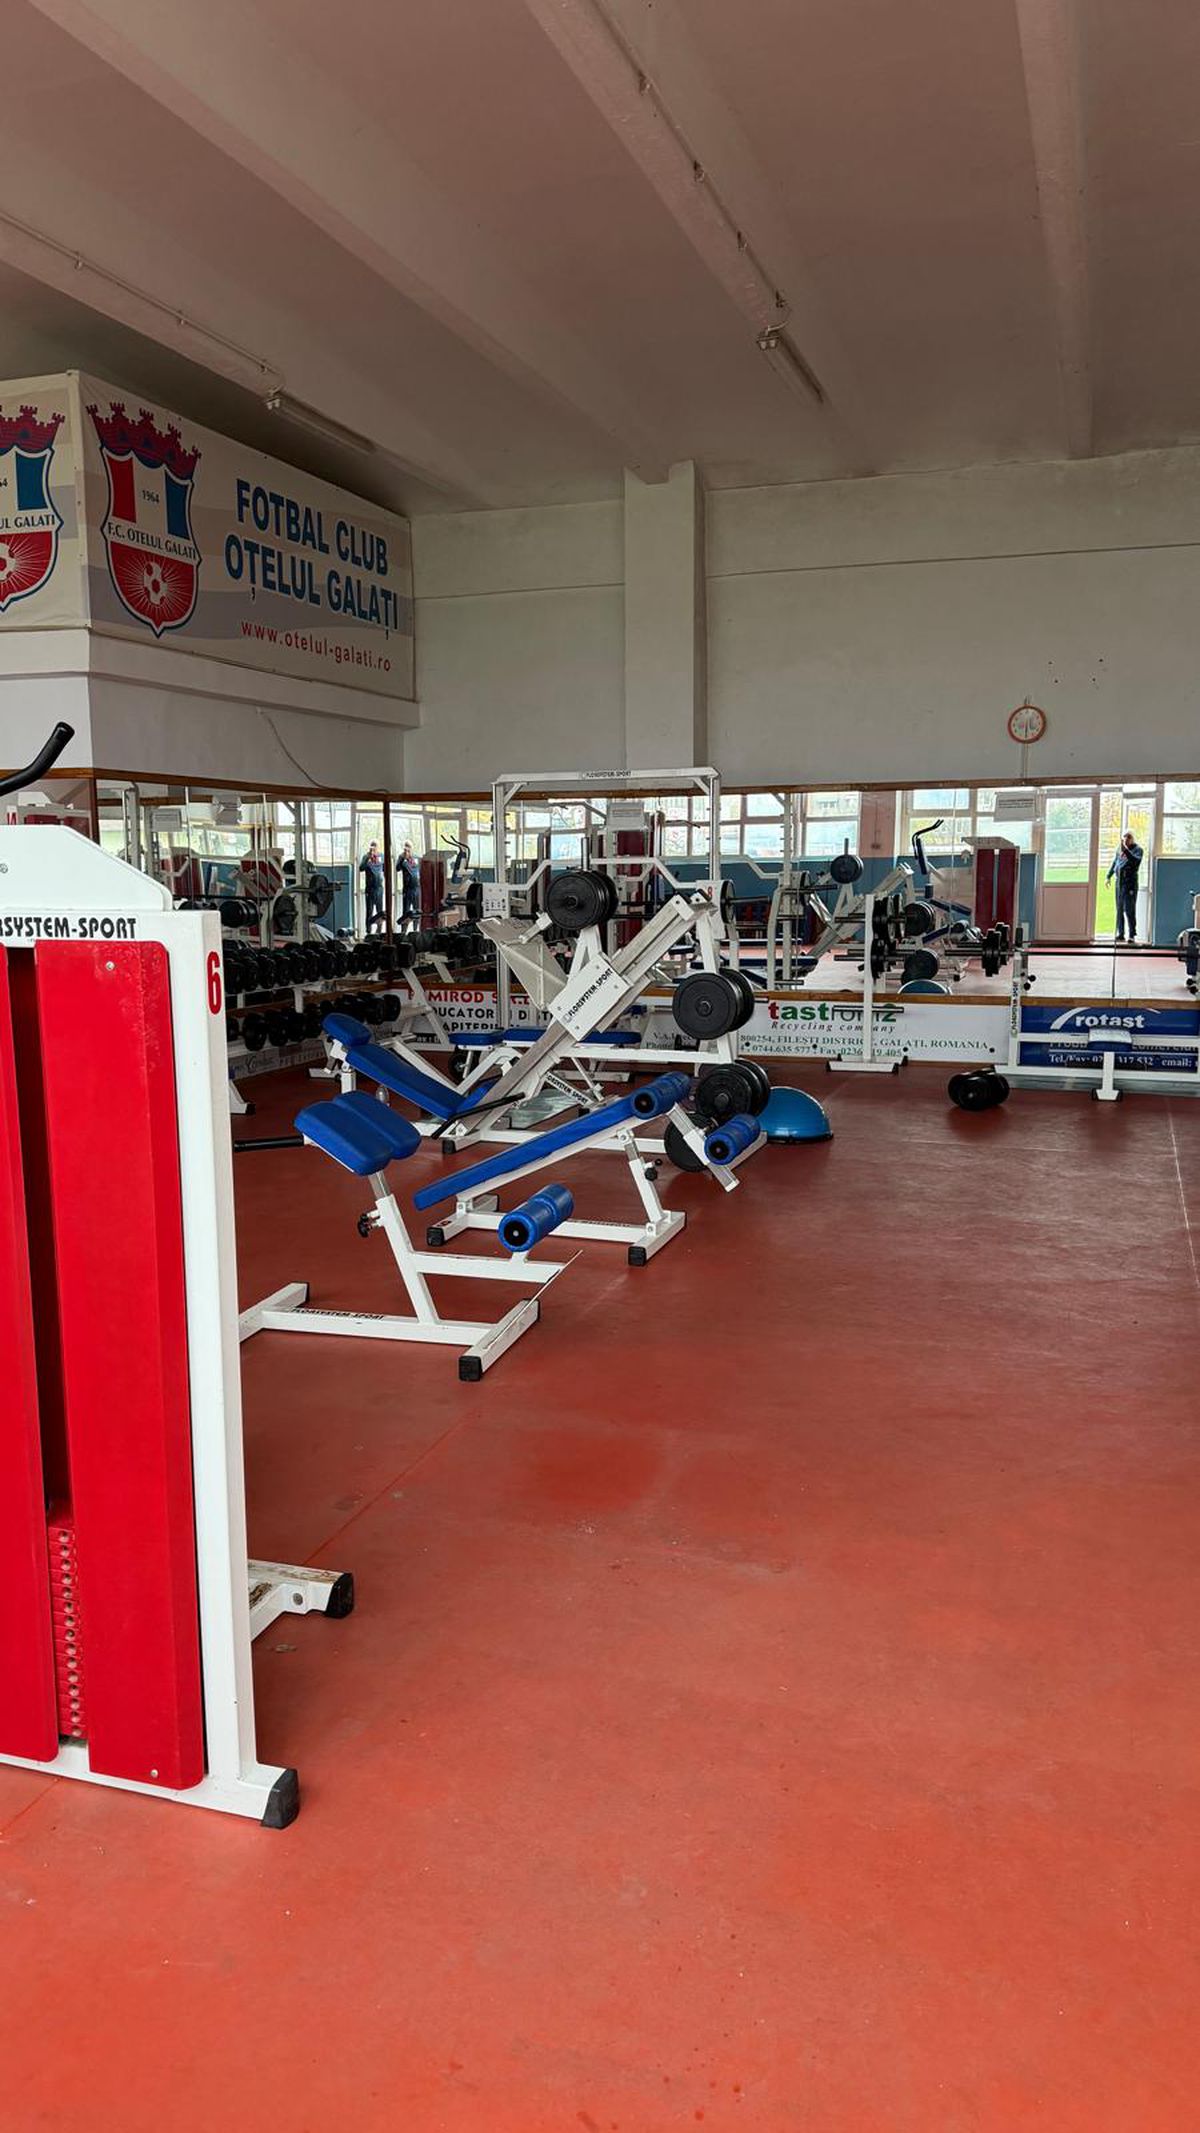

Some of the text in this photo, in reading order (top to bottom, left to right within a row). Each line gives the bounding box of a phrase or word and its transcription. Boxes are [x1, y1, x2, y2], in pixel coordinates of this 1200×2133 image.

[14, 513, 56, 529] GALATI
[236, 477, 389, 577] FOTBAL CLUB
[107, 521, 197, 560] F.C. OTELUL GALATI
[240, 620, 392, 672] www.otelul-galati.ro
[206, 950, 223, 1016] 6
[771, 1021, 896, 1034] Recycling comany
[1075, 1014, 1145, 1028] rotast
[930, 1040, 988, 1050] ROMANIA
